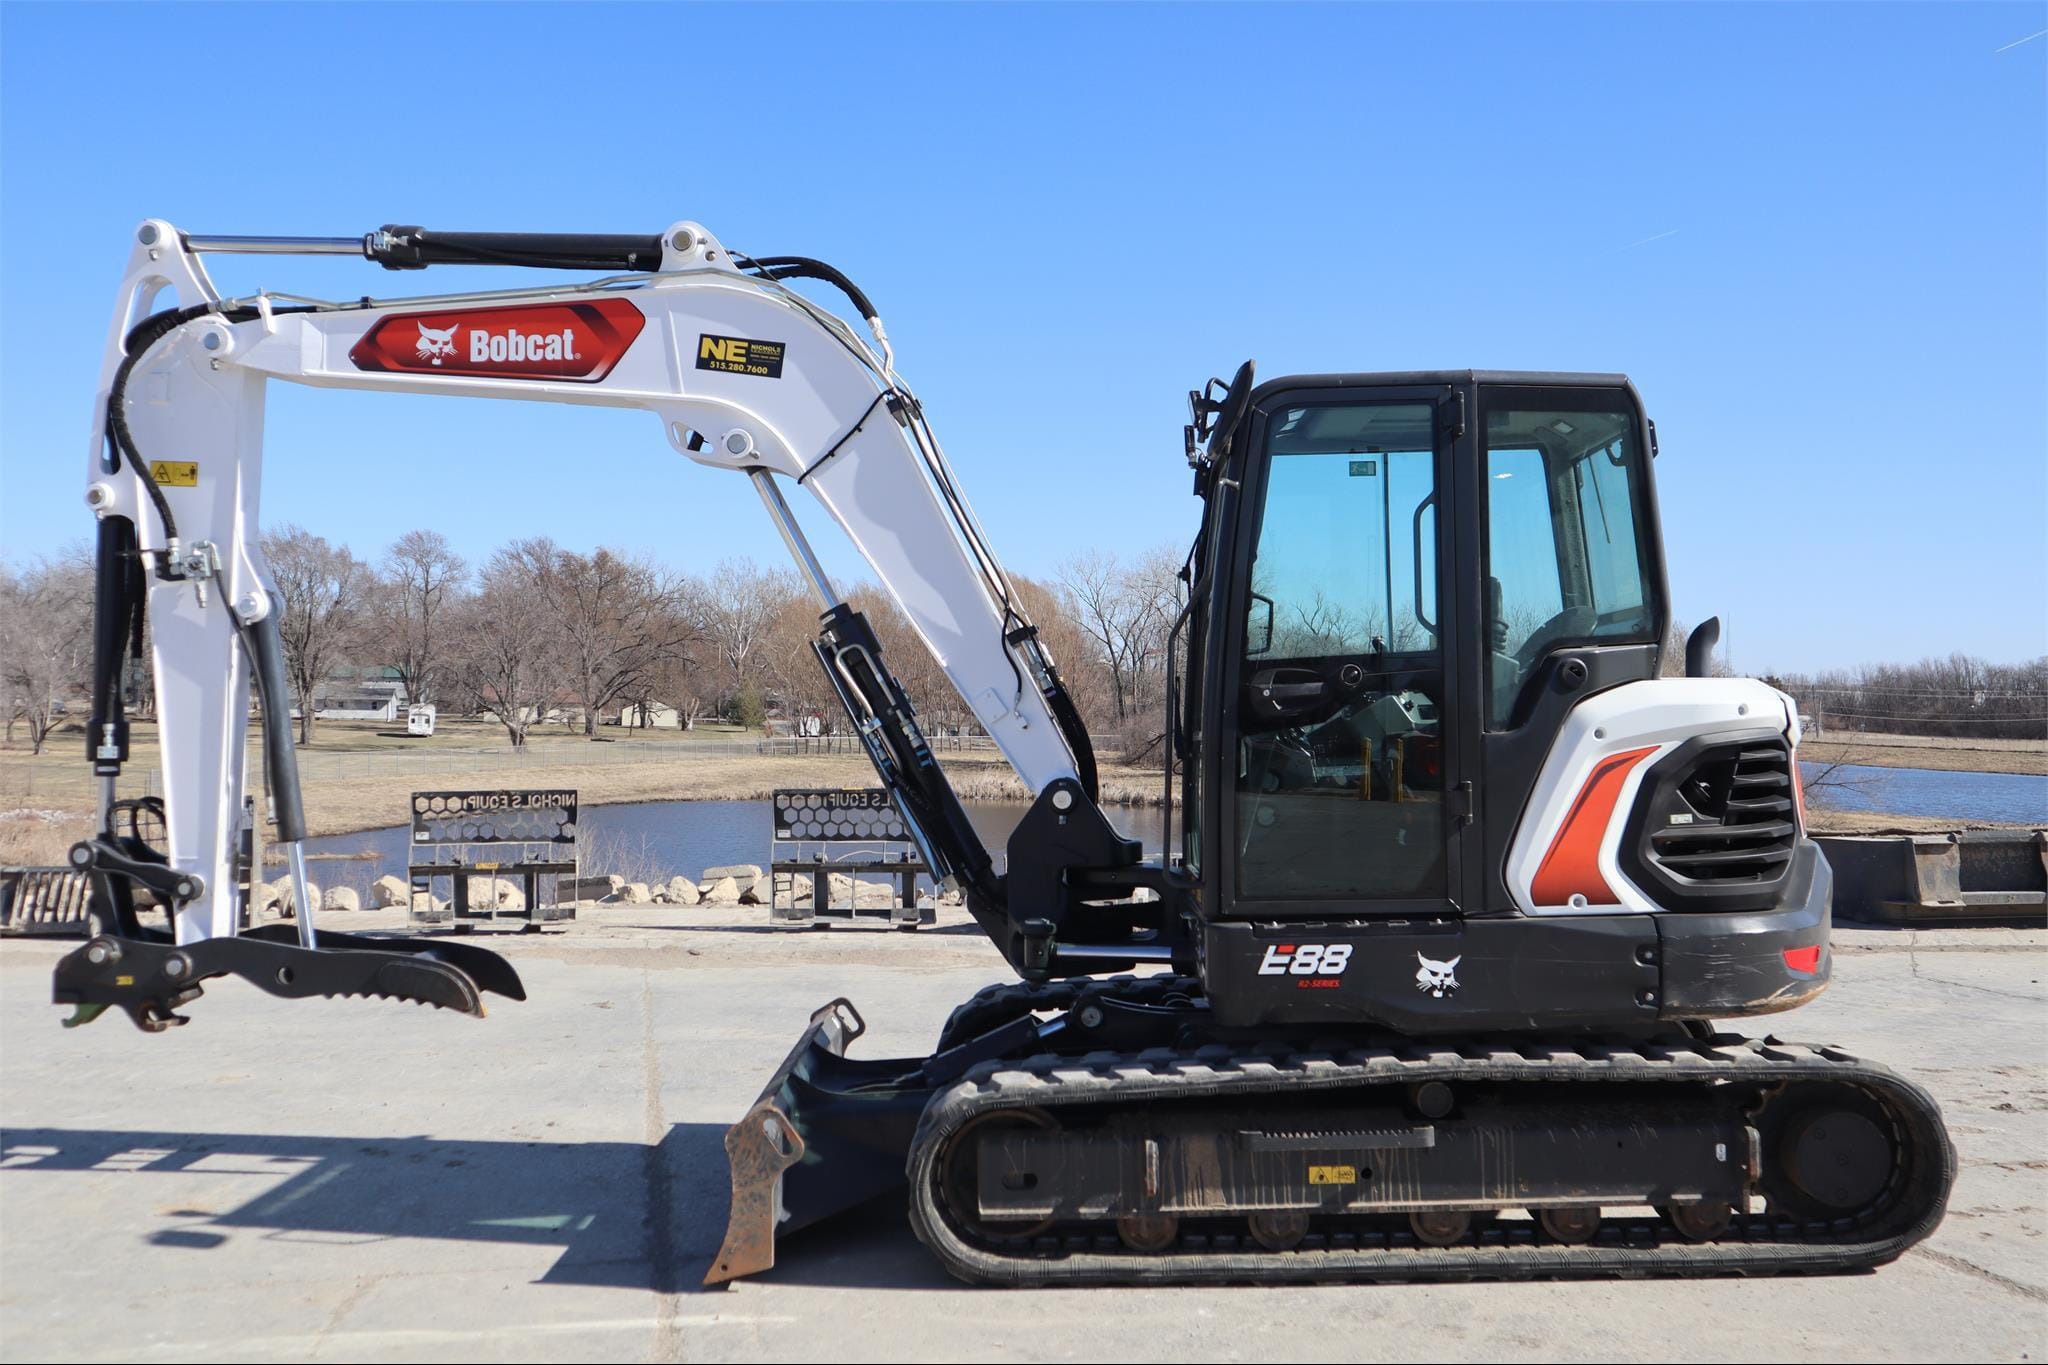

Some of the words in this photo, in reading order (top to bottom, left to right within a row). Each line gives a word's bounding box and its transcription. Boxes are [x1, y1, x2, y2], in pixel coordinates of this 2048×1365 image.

[470, 329, 574, 362] Bobcat
[700, 337, 749, 363] NE
[709, 361, 768, 374] 515.280.7600
[1258, 944, 1354, 975] E88
